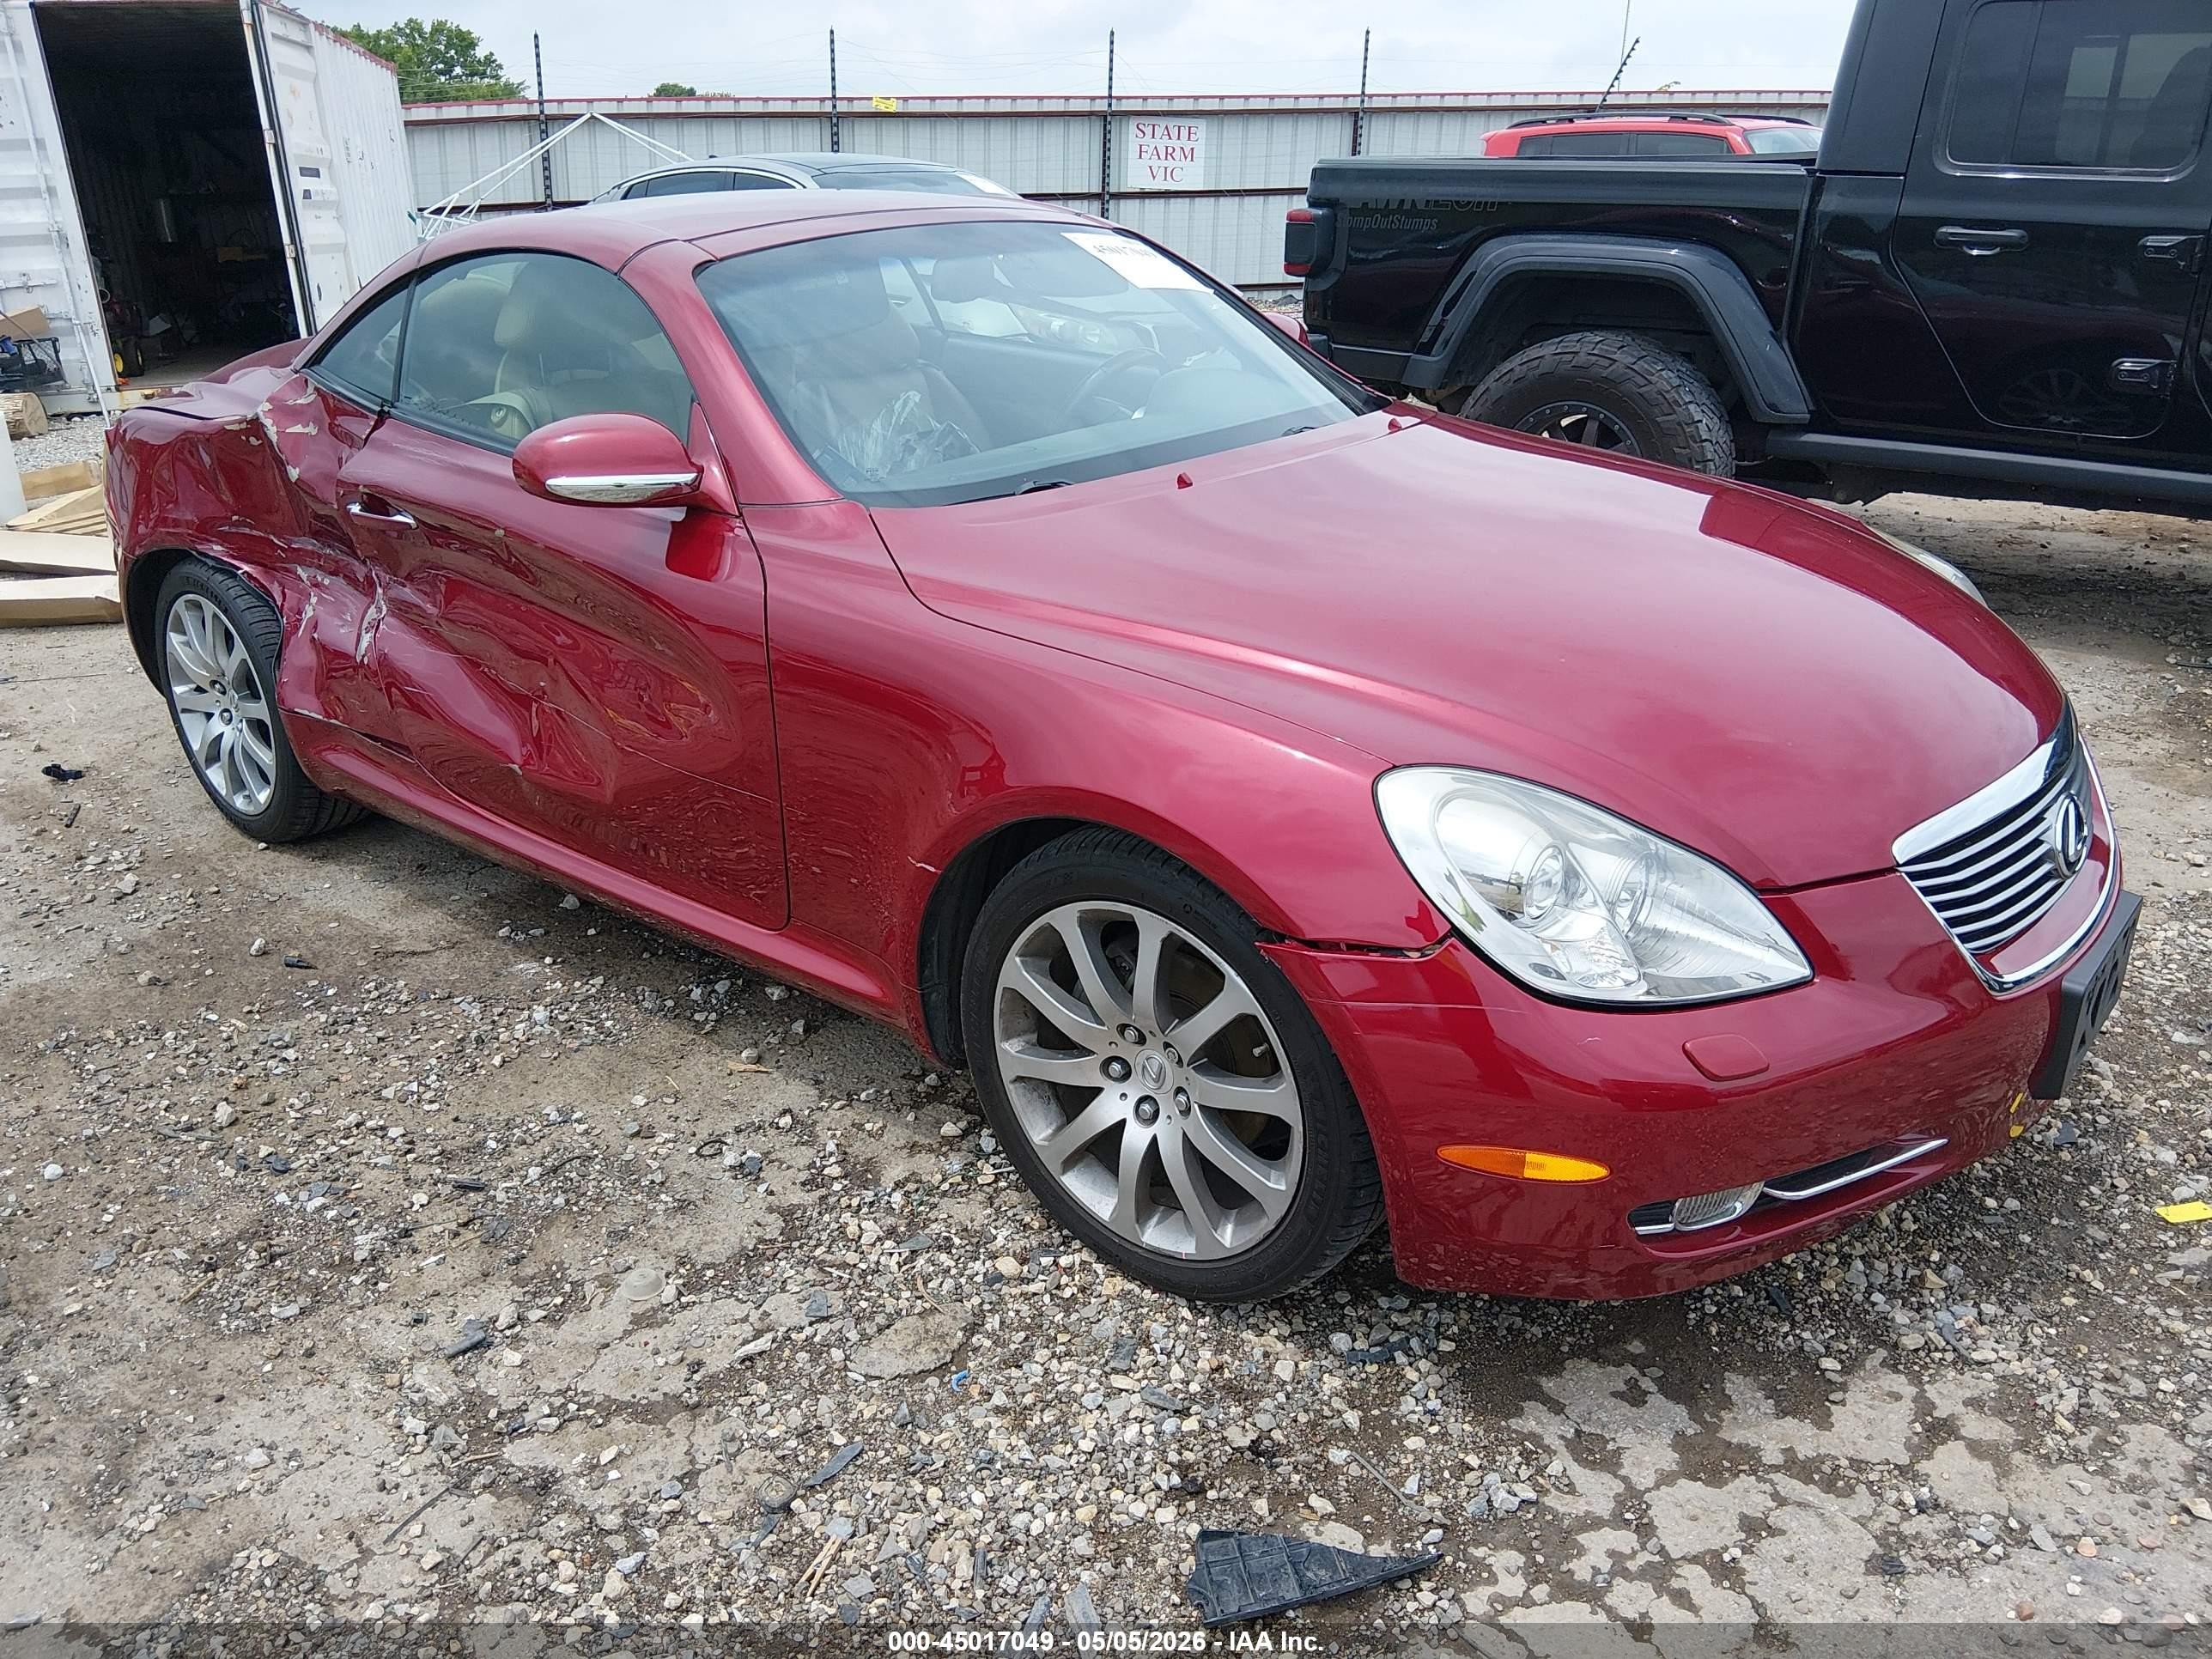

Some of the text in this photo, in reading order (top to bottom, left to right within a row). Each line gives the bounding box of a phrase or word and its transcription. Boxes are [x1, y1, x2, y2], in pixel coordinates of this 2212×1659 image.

[1135, 122, 1200, 143] STATE
[1137, 143, 1196, 163] FARM
[1147, 165, 1184, 183] VIC
